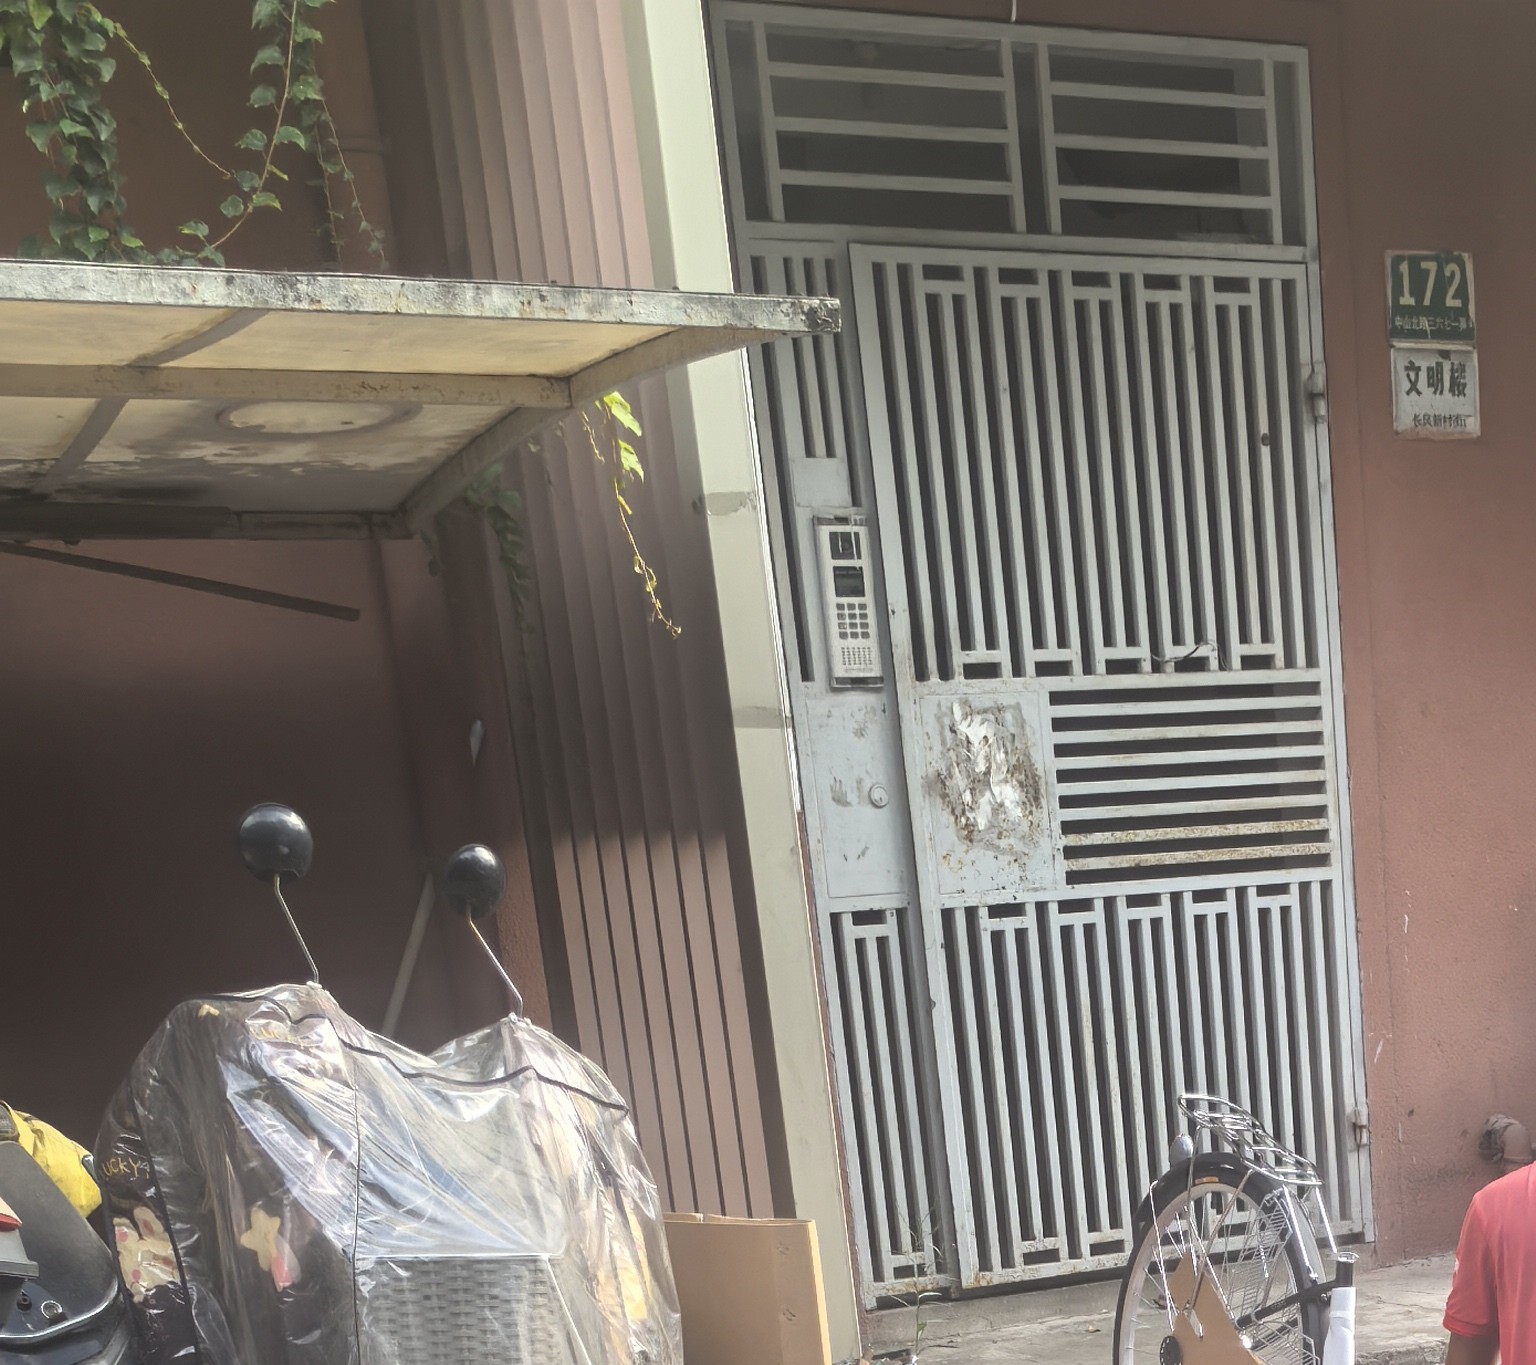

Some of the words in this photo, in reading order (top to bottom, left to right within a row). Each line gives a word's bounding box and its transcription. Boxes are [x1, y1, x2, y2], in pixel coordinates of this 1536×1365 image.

[1399, 260, 1462, 308] 172
[1404, 359, 1468, 398] 文明楼
